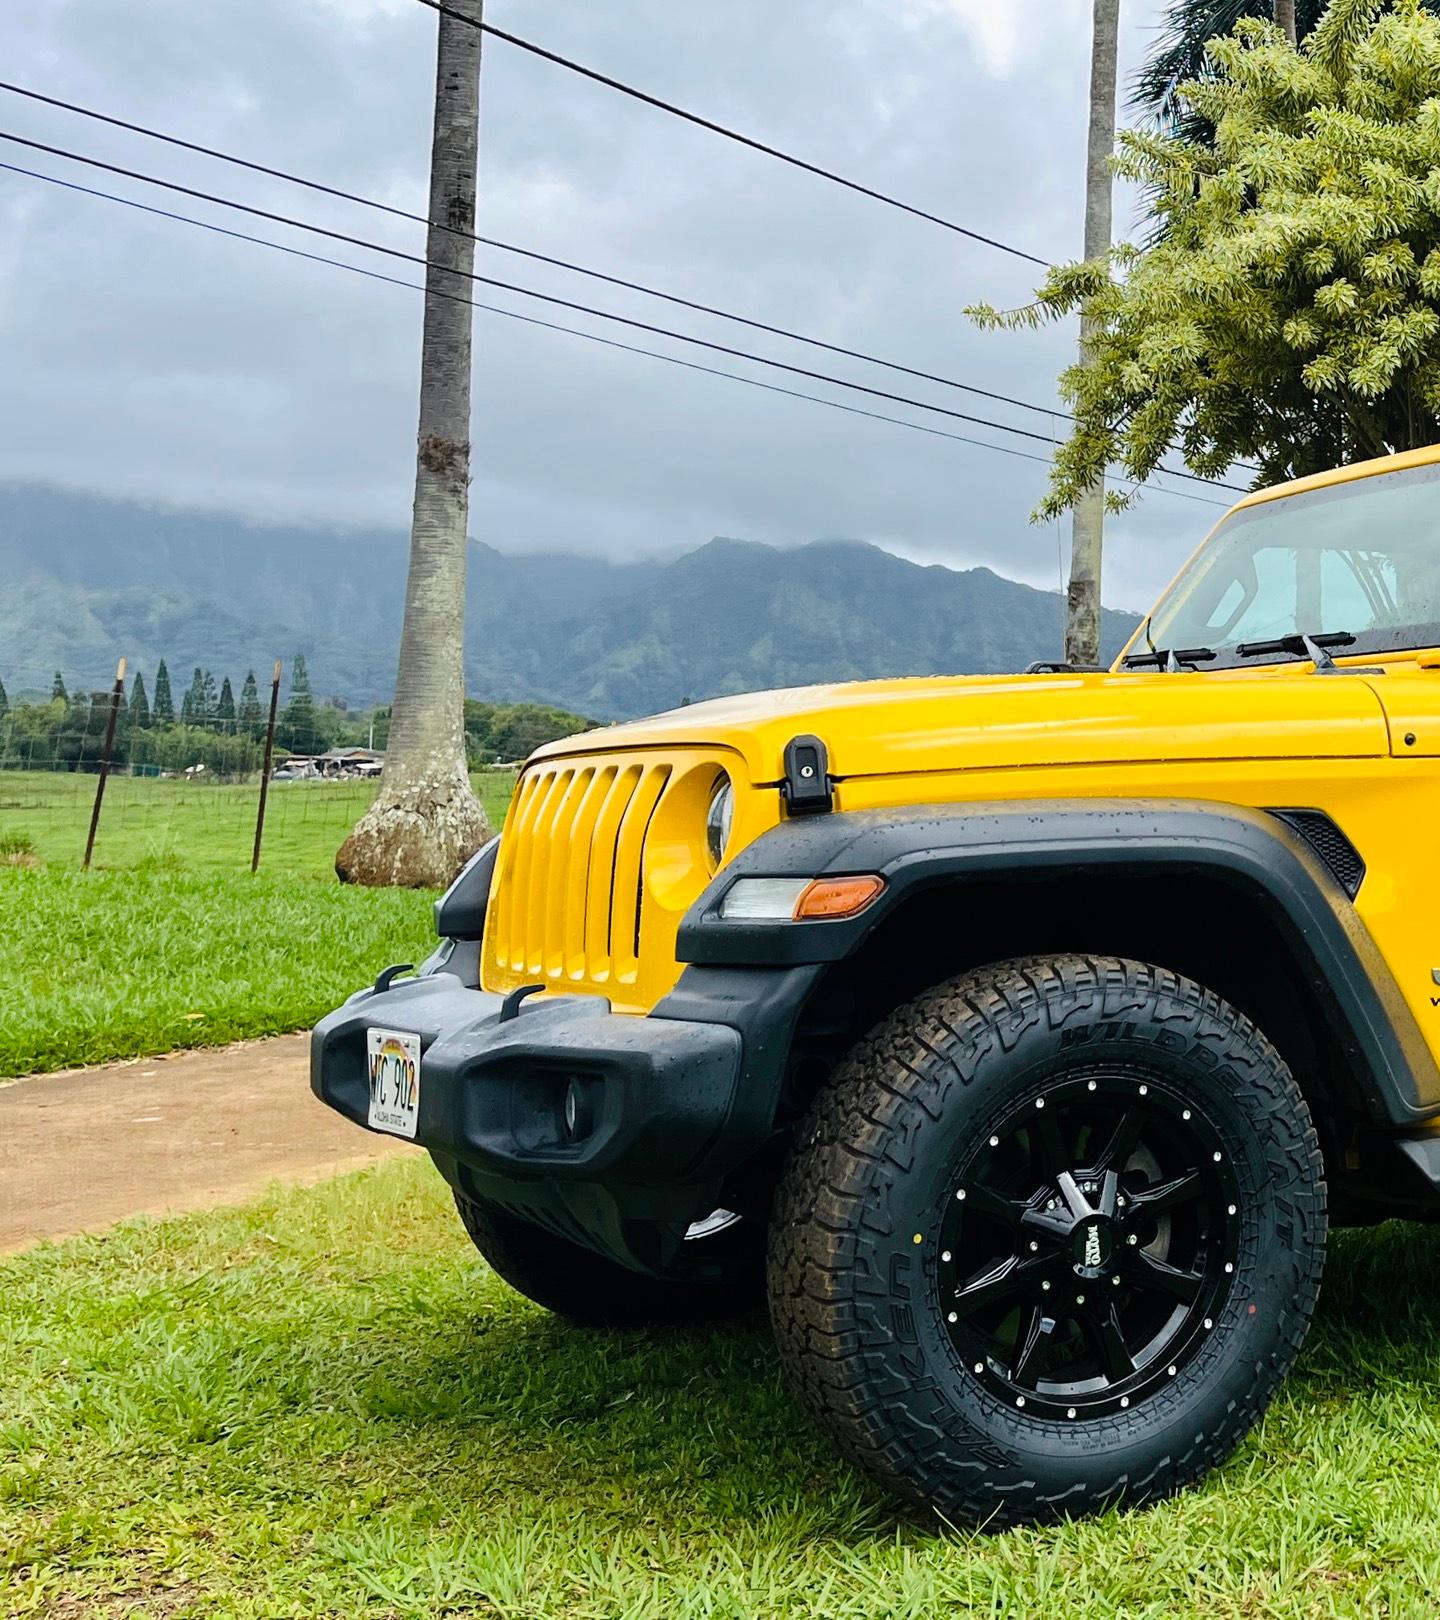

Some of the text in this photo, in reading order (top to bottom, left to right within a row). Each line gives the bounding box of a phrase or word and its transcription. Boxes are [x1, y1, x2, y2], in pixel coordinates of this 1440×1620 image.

[394, 1057, 415, 1112] 902
[1056, 1021, 1281, 1147] WILDPEAK
[889, 1252, 1023, 1469] FALKEN
